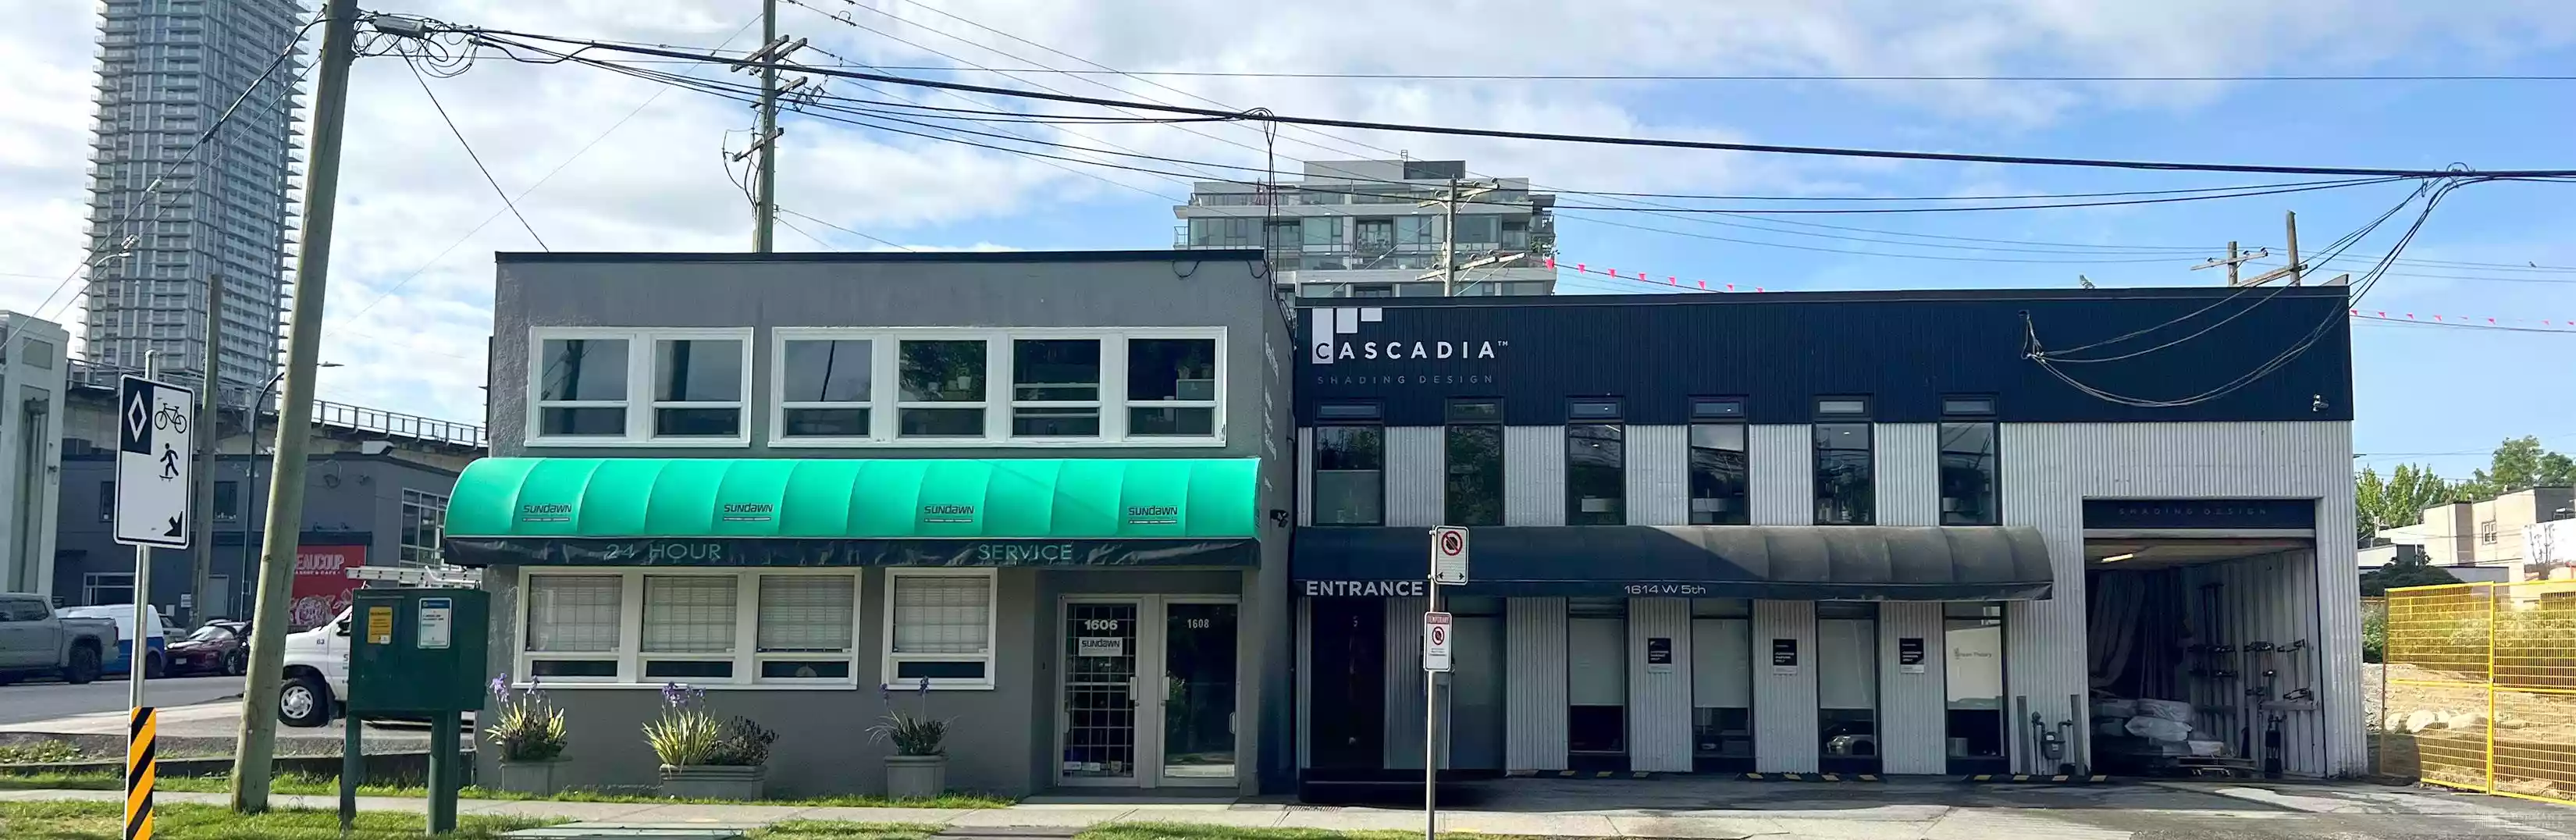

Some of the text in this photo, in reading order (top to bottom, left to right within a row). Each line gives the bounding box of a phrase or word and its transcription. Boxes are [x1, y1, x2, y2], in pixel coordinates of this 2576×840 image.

[1318, 375, 1493, 385] SHADING DESIGN
[604, 543, 721, 561] 24 HOUR
[977, 543, 1073, 561] SERVICE
[296, 553, 344, 571] EAUCOUP
[1306, 580, 1424, 596] ENTRANCE
[1624, 584, 1706, 594] 1614 W 5th
[1084, 619, 1119, 631] 1606
[1187, 618, 1210, 629] 1608
